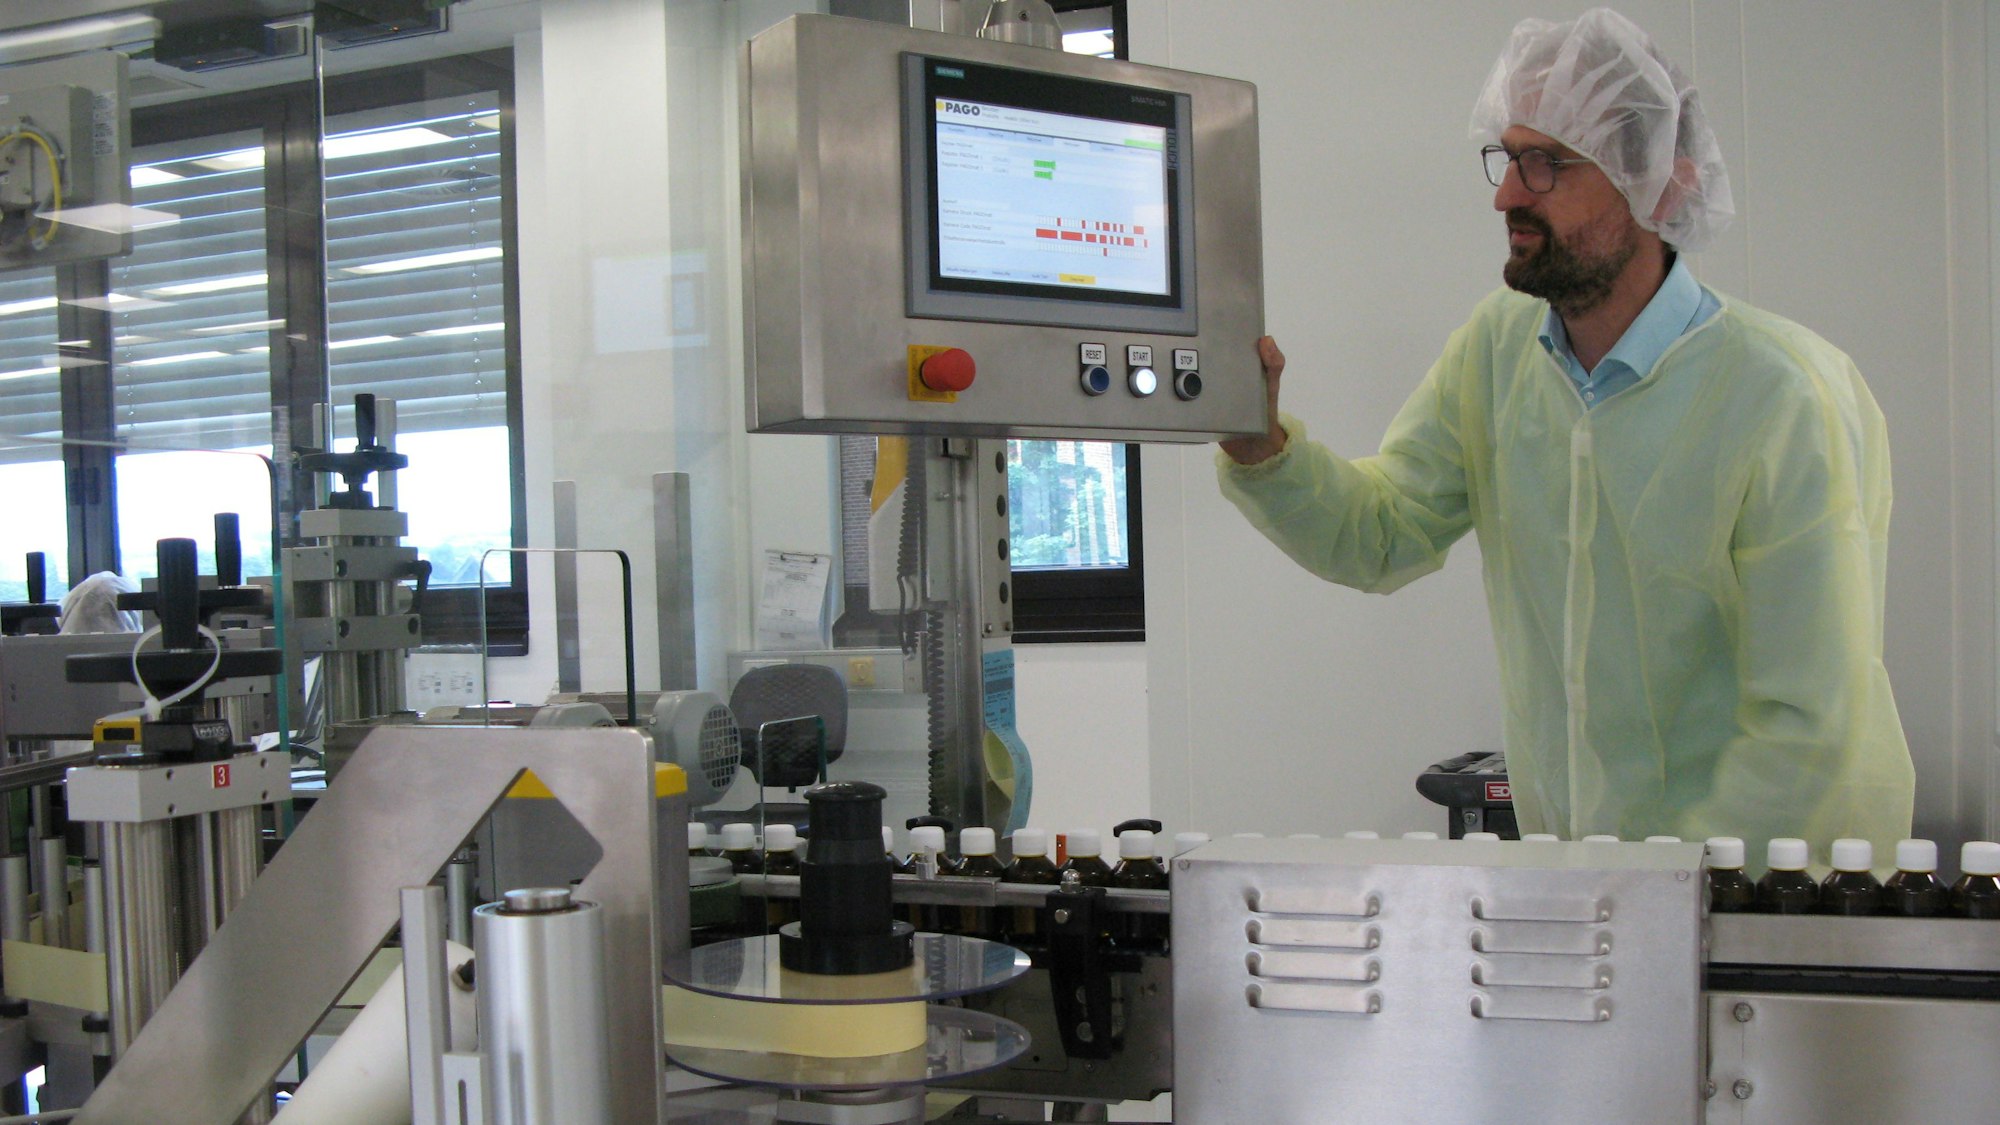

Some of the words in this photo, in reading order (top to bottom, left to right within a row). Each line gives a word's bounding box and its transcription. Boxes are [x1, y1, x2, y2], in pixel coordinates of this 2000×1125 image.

[945, 102, 980, 116] PAGO
[1167, 129, 1177, 169] TOUCH
[1085, 350, 1102, 360] RESET
[1132, 351, 1149, 361] START
[1180, 356, 1193, 365] STOP
[218, 766, 226, 785] 3
